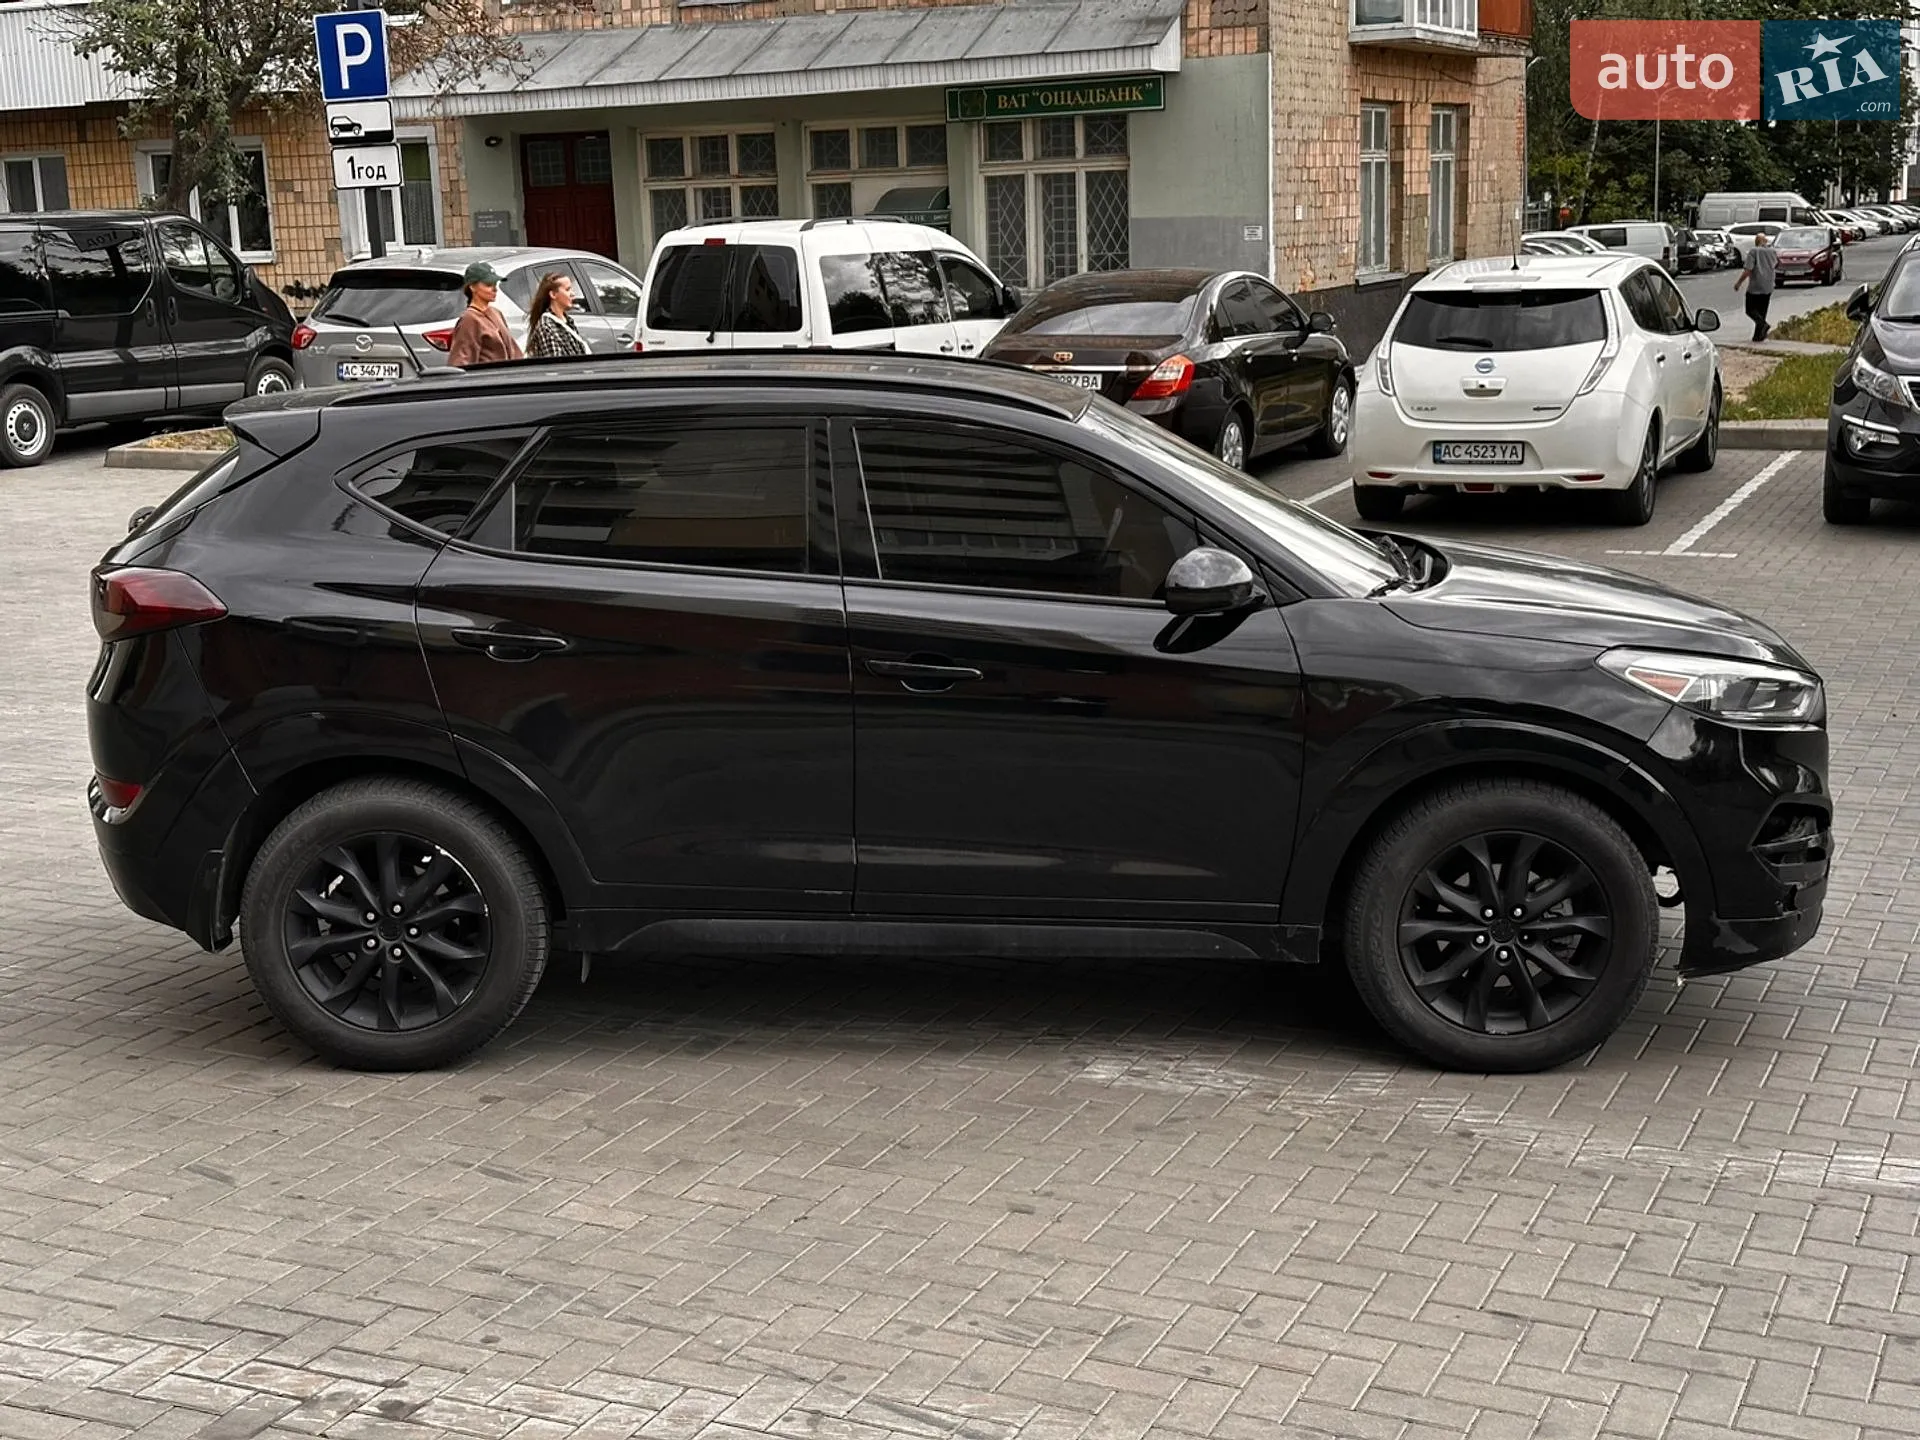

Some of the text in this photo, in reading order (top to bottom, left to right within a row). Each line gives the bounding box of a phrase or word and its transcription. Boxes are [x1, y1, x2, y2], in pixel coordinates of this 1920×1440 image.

[335, 23, 372, 90] P
[997, 93, 1030, 109] ВАТ
[344, 365, 357, 376] AC
[1442, 445, 1519, 459] AC 4523 YA
